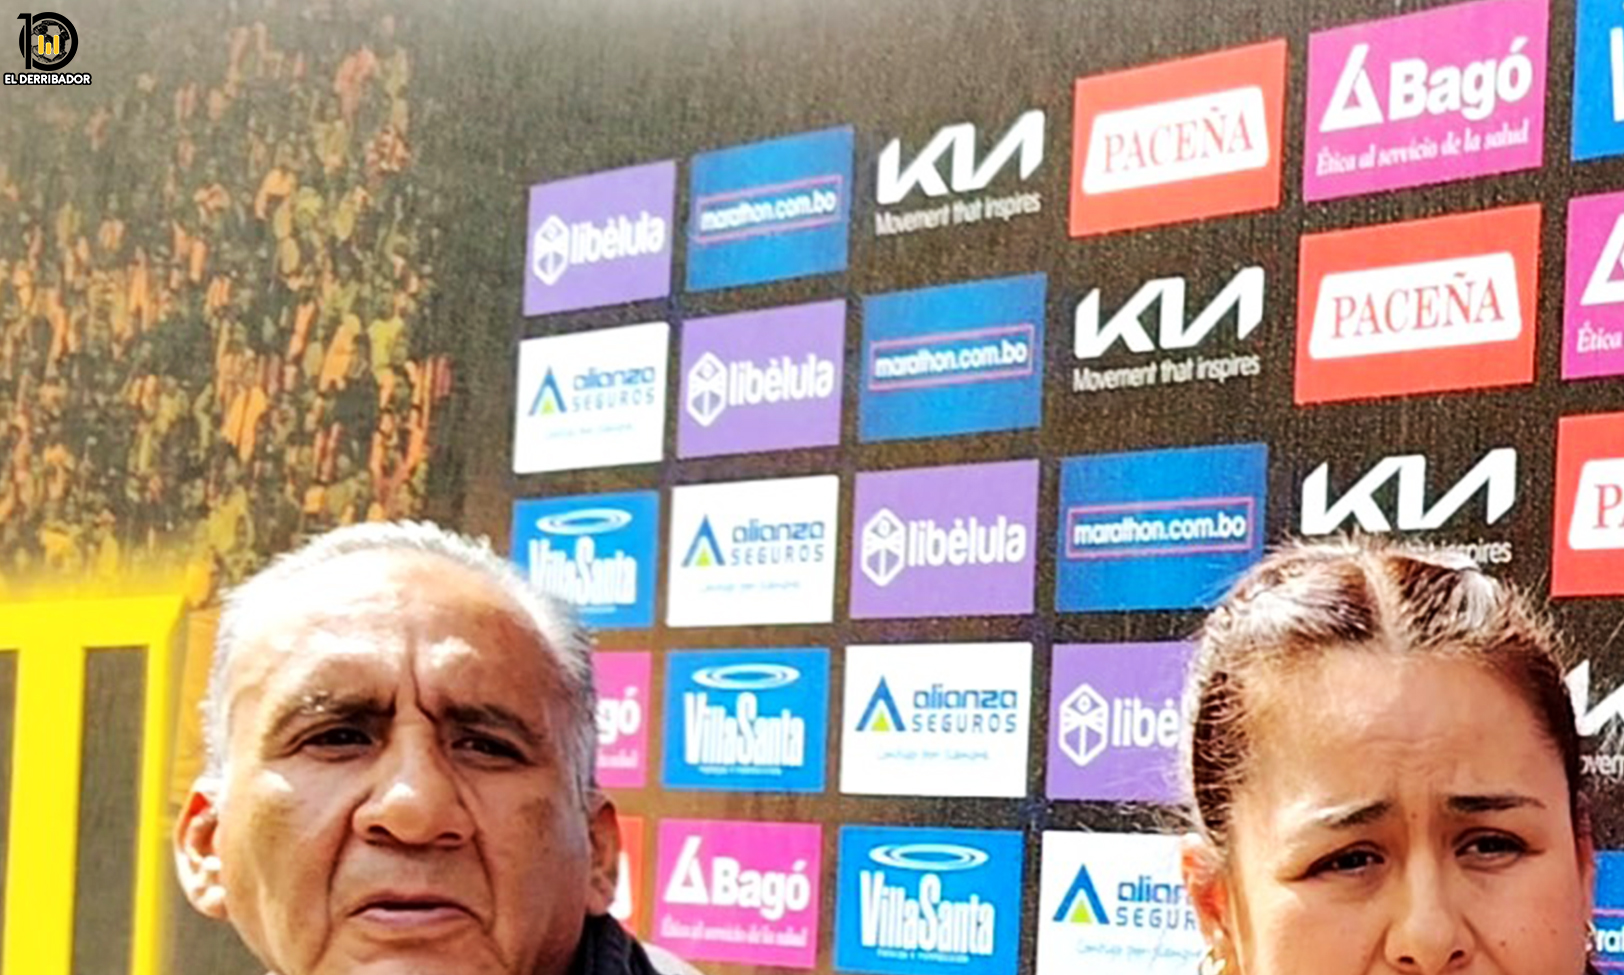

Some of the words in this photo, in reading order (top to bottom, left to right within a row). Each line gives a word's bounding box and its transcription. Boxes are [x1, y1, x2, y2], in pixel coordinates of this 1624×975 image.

[1389, 37, 1533, 122] Bagó
[877, 109, 1046, 206] KIA
[1103, 107, 1254, 174] PACEÑA
[1315, 146, 1356, 177] Ética
[1358, 144, 1376, 170] al
[1378, 137, 1438, 167] servicio
[1441, 130, 1462, 156] de
[1463, 127, 1481, 153] la
[1483, 118, 1530, 149] salud
[700, 190, 837, 232] marathon.com.bo
[875, 203, 950, 236] Movement
[952, 199, 983, 225] that
[984, 191, 1042, 222] inspires
[1074, 266, 1266, 360] KIA
[1331, 271, 1506, 339] PACEÑA
[875, 339, 1028, 378] marathon.com.bo
[1577, 321, 1623, 354] Ética
[1073, 362, 1157, 392] Movement
[1160, 358, 1194, 383] that
[1197, 353, 1261, 384] inspires
[1301, 448, 1517, 535] KIA
[732, 518, 825, 544] alianza
[1073, 512, 1246, 546] marathon.com.bo
[731, 544, 825, 566] SEGUROS
[596, 687, 641, 745] gó
[913, 684, 1018, 710] alianza
[912, 713, 1017, 733] SEGUROS
[712, 859, 811, 921] Bagó
[1116, 906, 1197, 931] SEGUR
